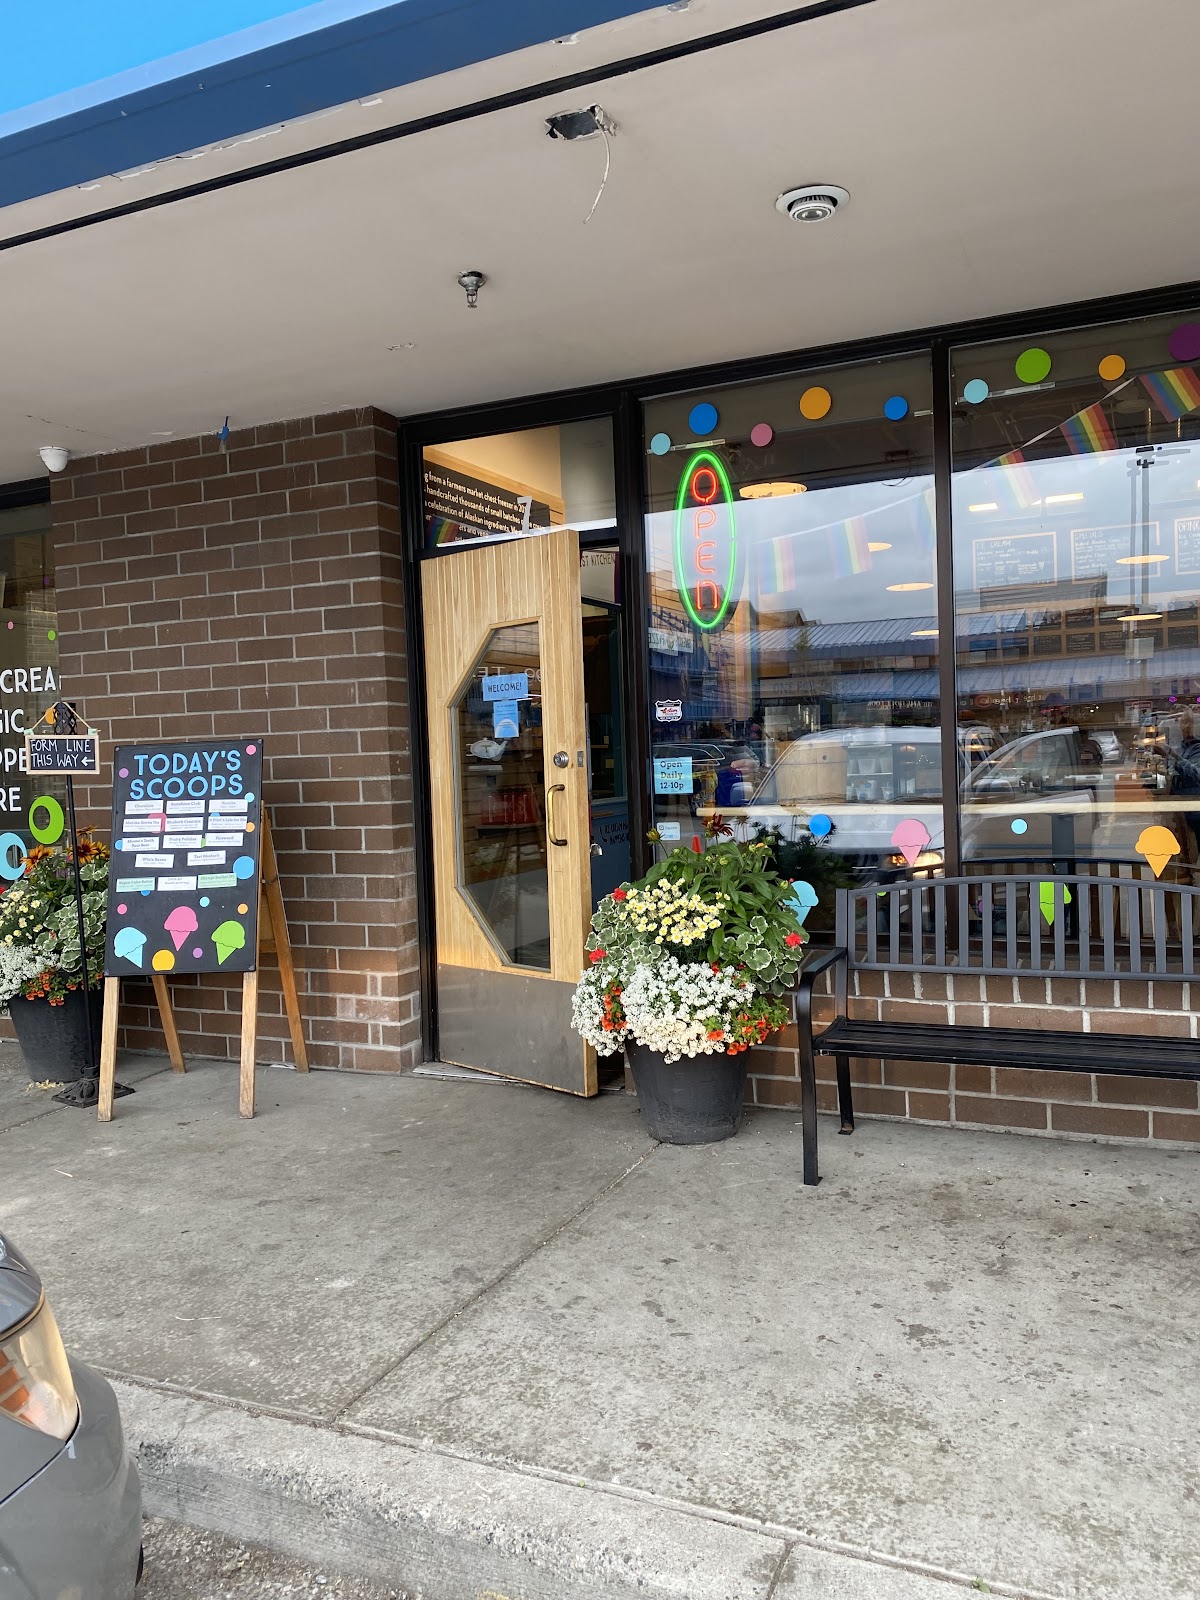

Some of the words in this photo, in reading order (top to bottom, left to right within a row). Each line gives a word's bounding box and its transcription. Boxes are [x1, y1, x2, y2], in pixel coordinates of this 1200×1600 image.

[428, 471, 442, 485] from
[446, 477, 466, 493] farmers
[466, 487, 484, 500] market
[484, 492, 498, 505] chest
[497, 495, 514, 509] freezer
[426, 484, 459, 504] handcrafted
[458, 496, 484, 513] thousands
[484, 504, 491, 514] of
[490, 508, 503, 519] small
[502, 510, 521, 524] batches
[428, 500, 458, 517] celebration
[458, 508, 464, 518] of
[464, 510, 484, 525] Alaskan
[516, 495, 533, 535] 7
[487, 682, 522, 693] WELCOME!
[30, 739, 58, 752] FORM
[66, 739, 91, 753] LINE
[31, 753, 53, 767] THIS
[57, 753, 79, 767] WAY
[133, 749, 241, 776] TODAY'S
[660, 761, 683, 770] Open
[660, 771, 683, 780] Daily
[129, 774, 243, 800] SCOOPS
[660, 781, 684, 791] 12-10p
